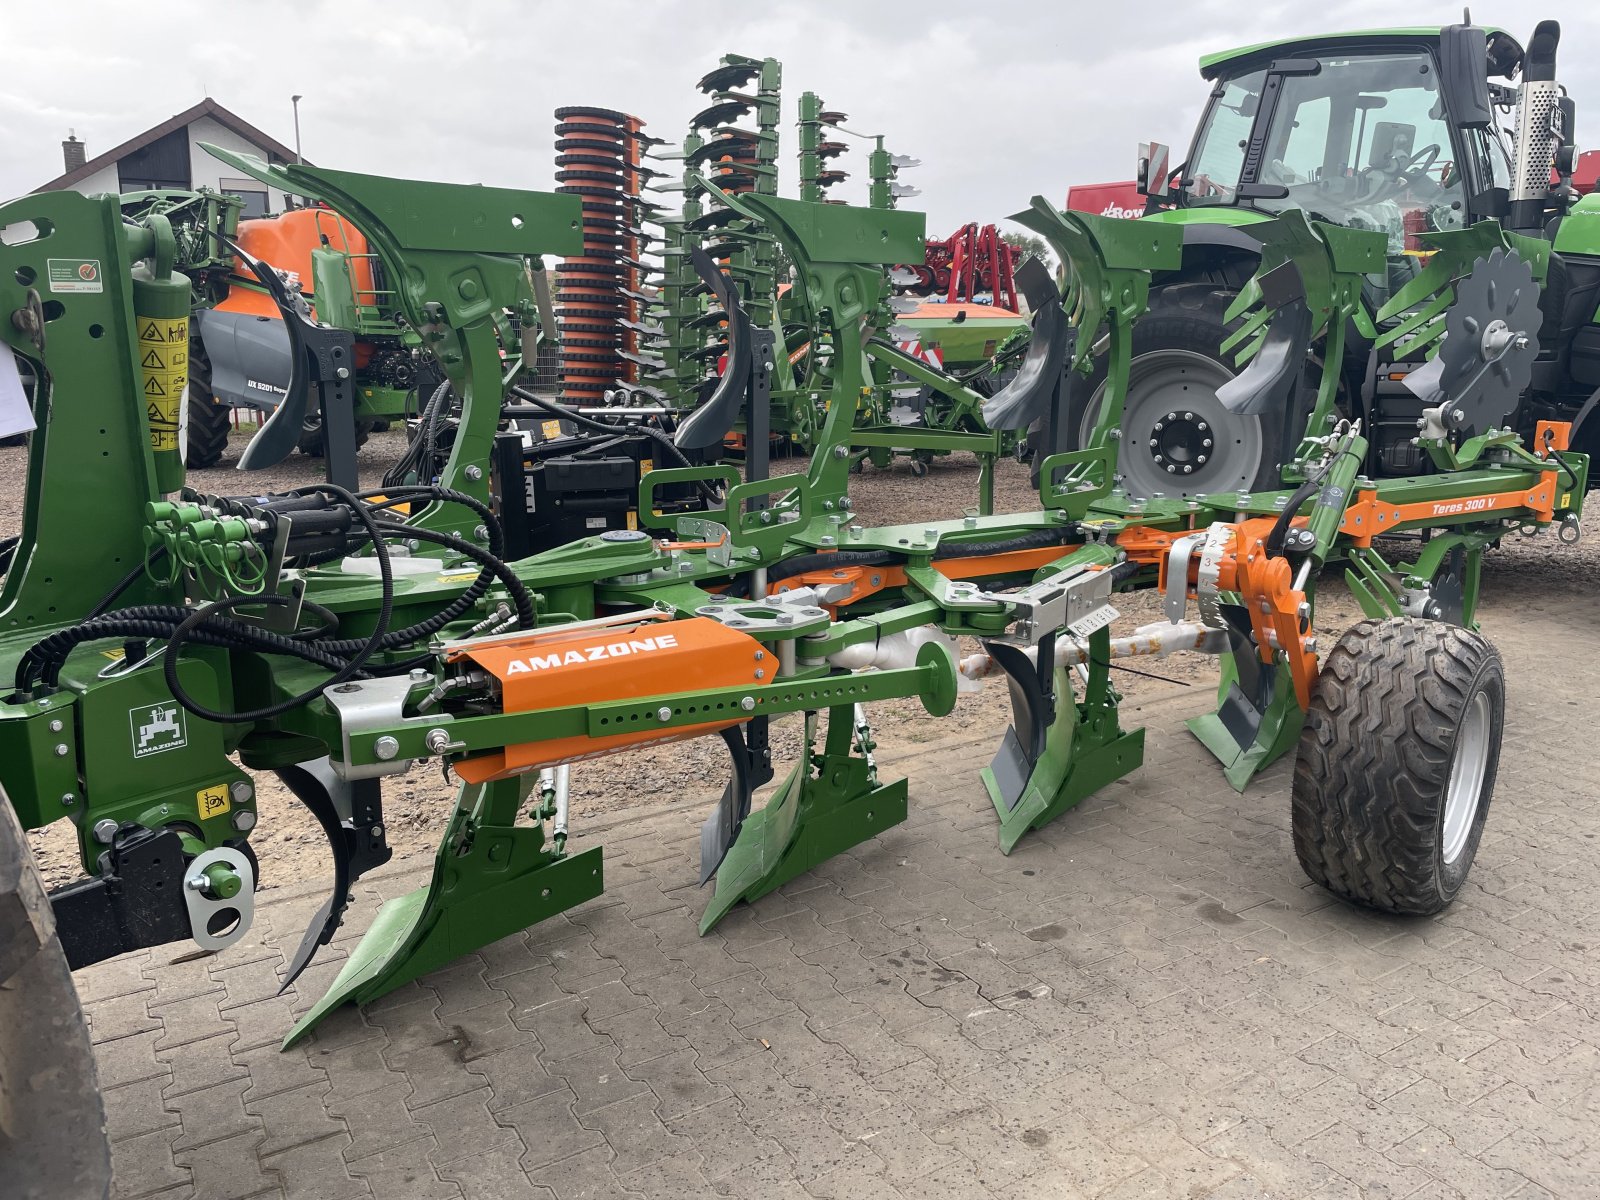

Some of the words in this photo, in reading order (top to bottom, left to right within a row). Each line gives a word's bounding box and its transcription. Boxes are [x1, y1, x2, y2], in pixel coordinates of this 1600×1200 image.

[248, 379, 257, 389] UX
[257, 382, 273, 392] 5201
[1432, 503, 1463, 515] Teres
[1464, 499, 1486, 511] 300
[1487, 497, 1496, 508] V
[506, 634, 678, 676] AMAZONE
[136, 739, 185, 755] AMAZONE
